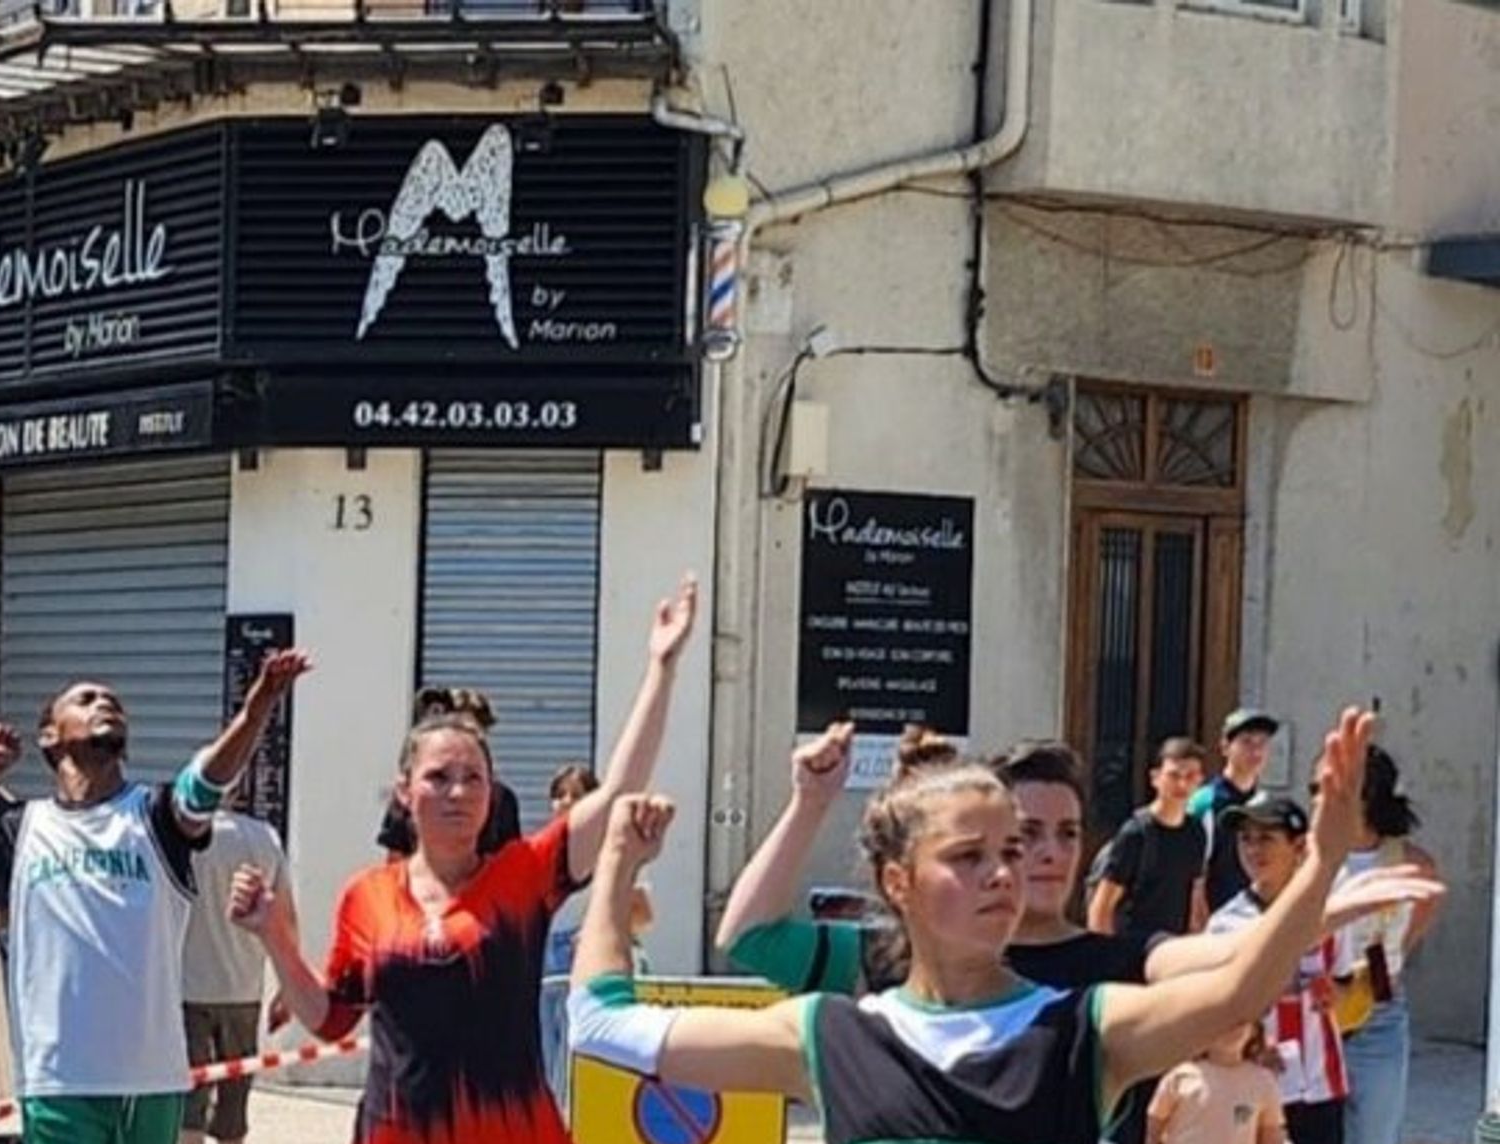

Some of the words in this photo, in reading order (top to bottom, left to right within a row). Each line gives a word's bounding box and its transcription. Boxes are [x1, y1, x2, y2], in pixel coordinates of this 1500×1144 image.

[331, 208, 571, 256] Mademoiselle
[531, 286, 565, 309] by
[65, 318, 83, 359] by
[528, 320, 616, 340] Marion
[354, 401, 577, 427] 04.42.03.03.03
[23, 417, 45, 453] DE
[328, 494, 373, 530] 13
